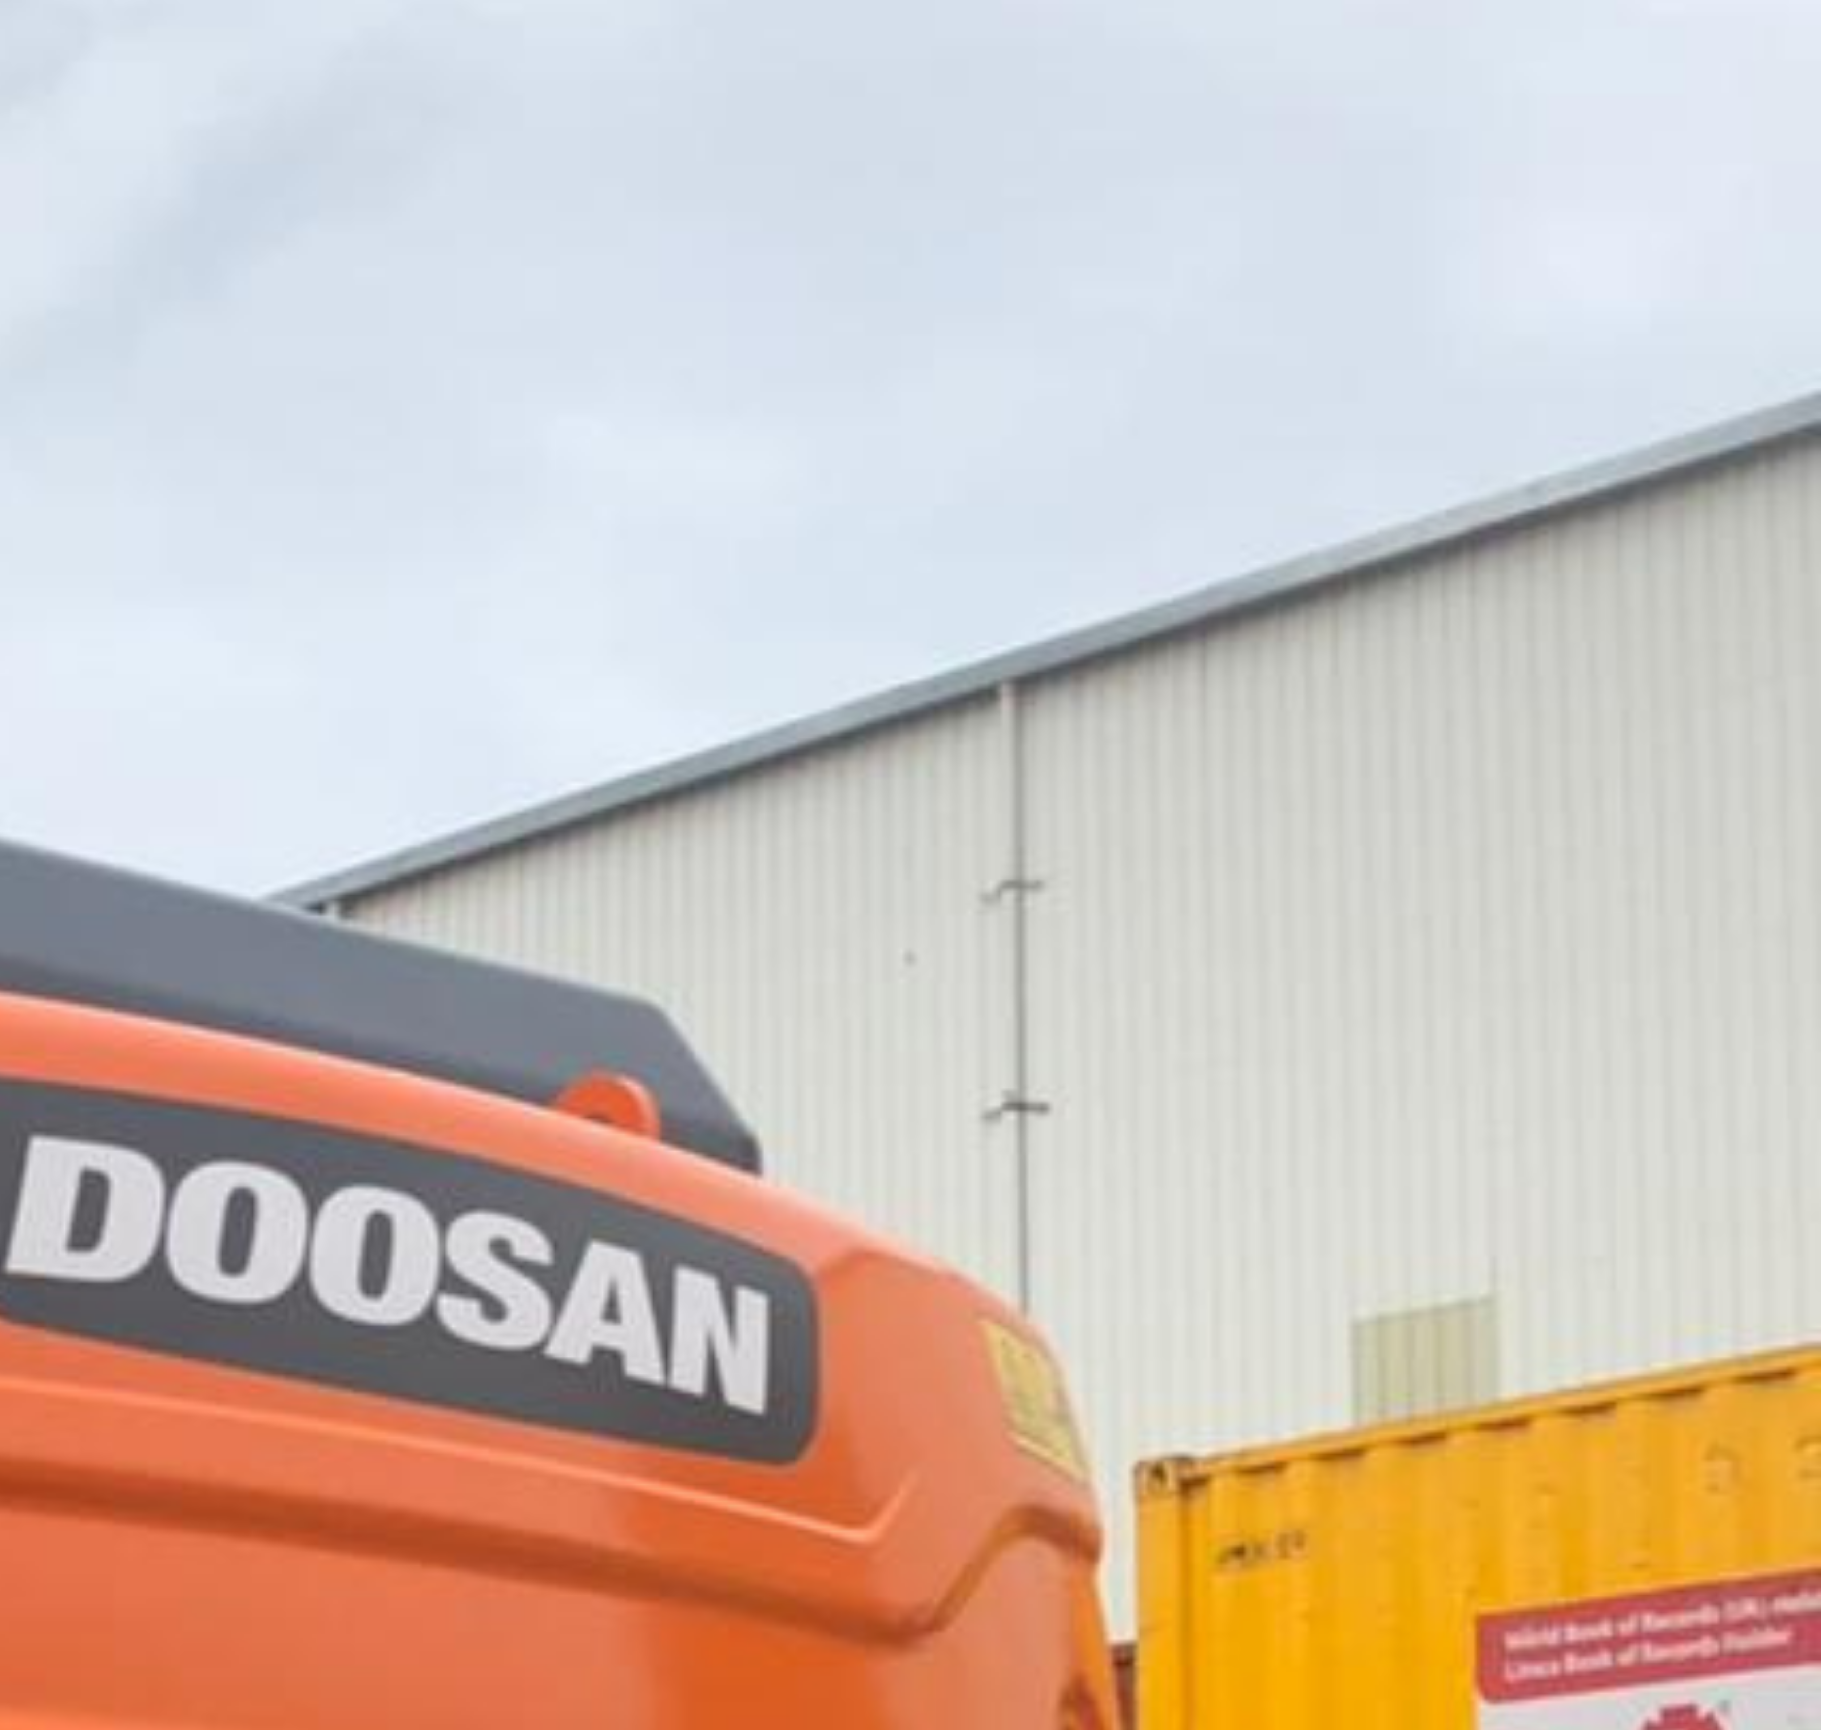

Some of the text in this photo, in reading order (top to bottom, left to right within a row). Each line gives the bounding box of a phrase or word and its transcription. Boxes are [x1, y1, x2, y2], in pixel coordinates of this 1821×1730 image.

[5, 1133, 769, 1416] DOOSAN
[1564, 1616, 1612, 1643] Book
[1616, 1612, 1638, 1636] of
[1564, 1651, 1612, 1676] Book
[1616, 1643, 1638, 1668] of
